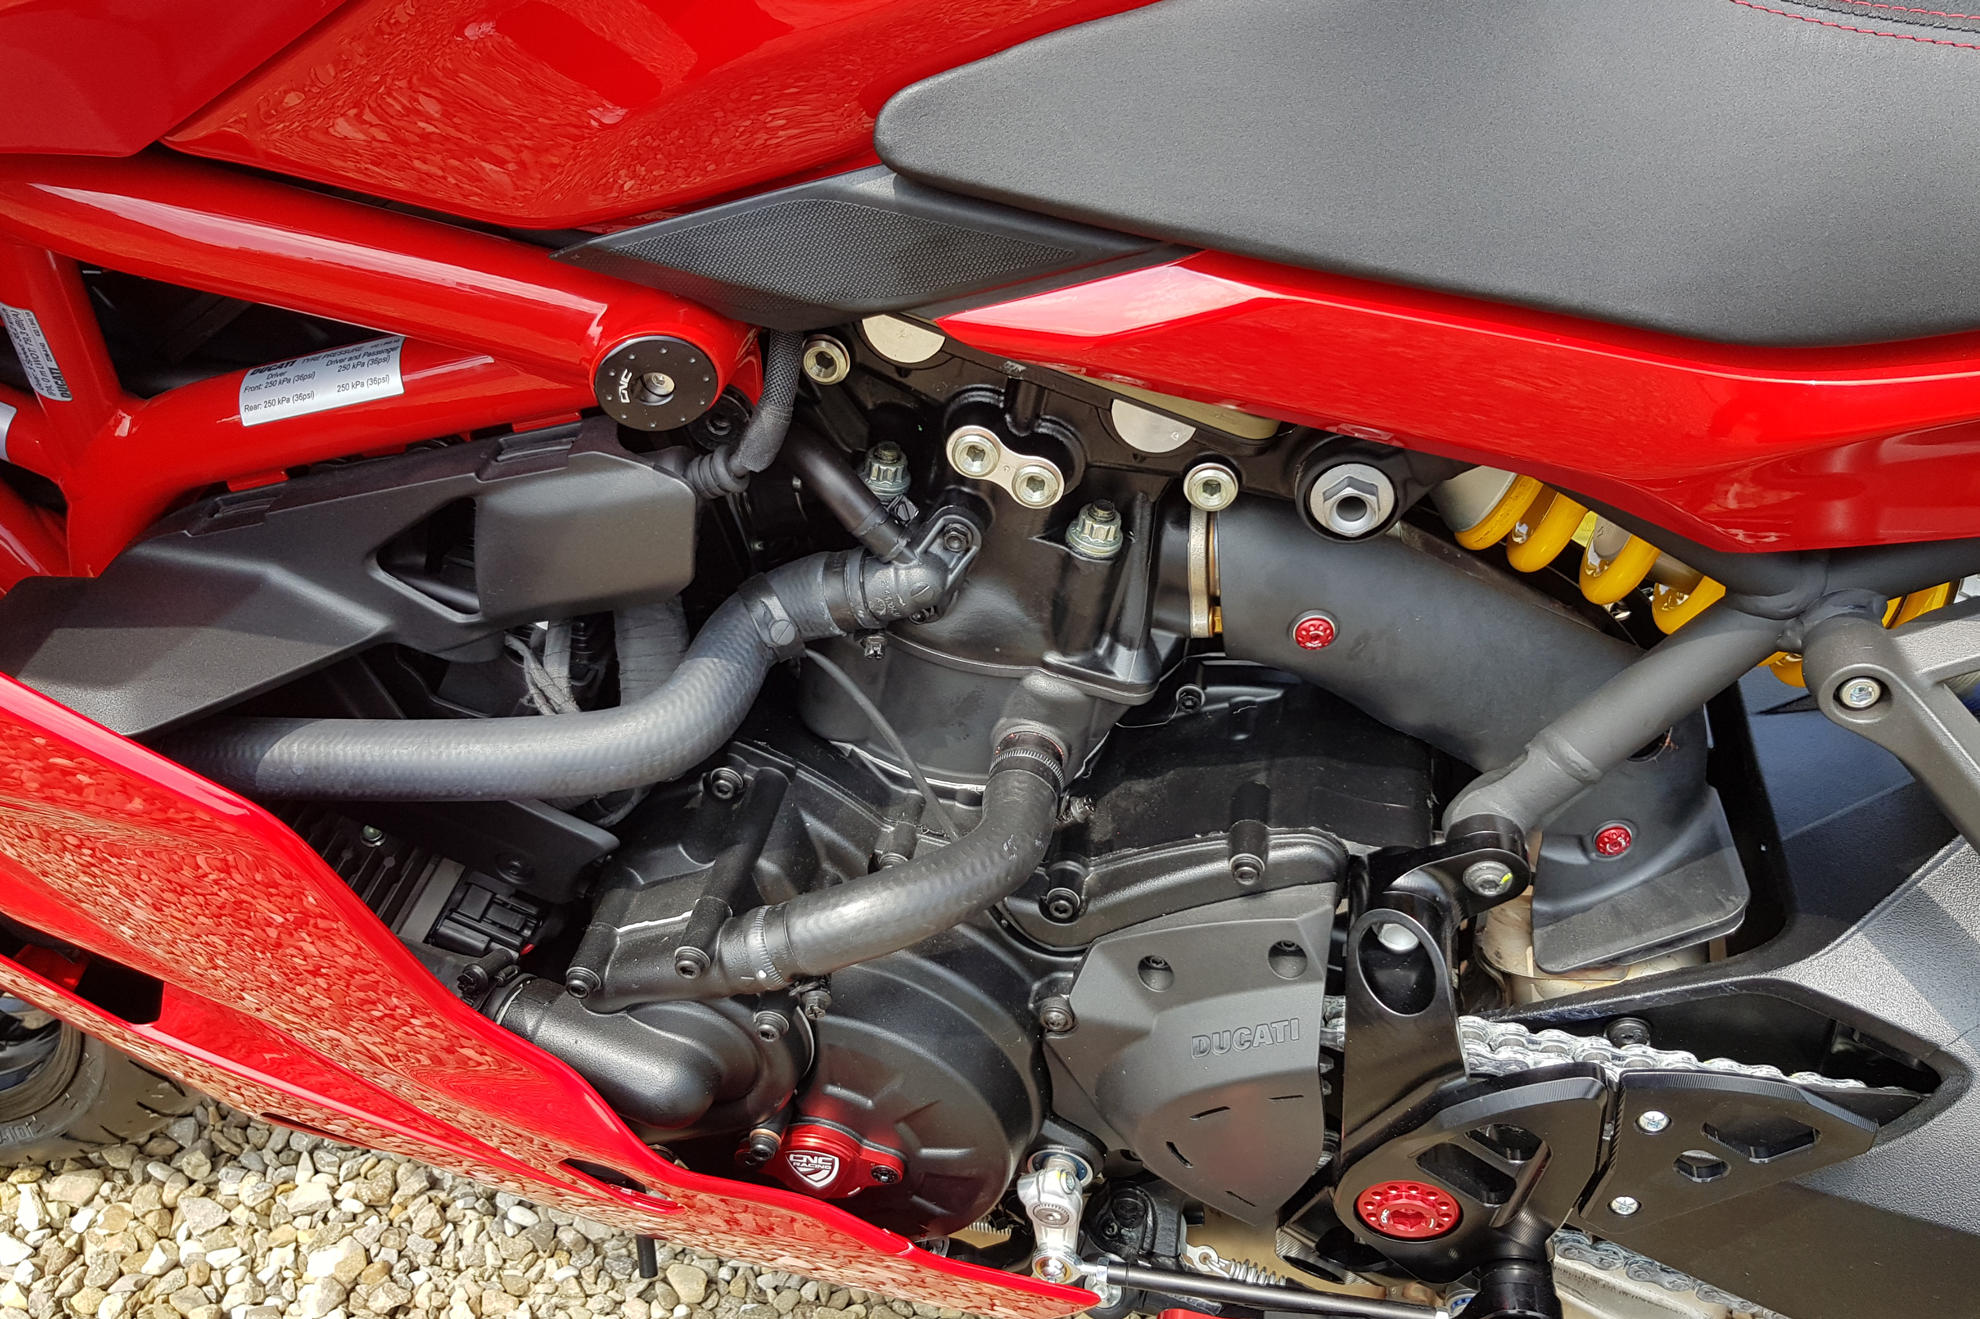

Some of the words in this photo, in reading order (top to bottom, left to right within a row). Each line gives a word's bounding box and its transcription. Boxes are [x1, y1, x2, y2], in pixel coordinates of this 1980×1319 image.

[249, 360, 298, 376] DUCATI
[322, 346, 364, 360] PRESSURE
[326, 358, 347, 366] Driver
[348, 354, 361, 362] and
[362, 346, 400, 359] Passenger
[338, 364, 351, 372] 250
[352, 361, 365, 369] kPa
[367, 355, 391, 368] (36psi)
[48, 367, 71, 398] DUCATI
[243, 384, 262, 393] Front:
[264, 380, 278, 389] 250
[278, 377, 291, 386] kPa
[293, 371, 315, 384] (36psi)
[266, 371, 288, 379] Driver
[337, 383, 350, 392] 250
[352, 380, 364, 389] kPa
[367, 374, 390, 388] (36psi)
[244, 404, 262, 413] Rear:
[264, 399, 276, 409] 250
[278, 396, 290, 405] kPa
[292, 390, 315, 404] (36psi)
[1191, 1018, 1299, 1059] DUCATI
[789, 1154, 833, 1165] CNC
[793, 1162, 832, 1170] RACING
